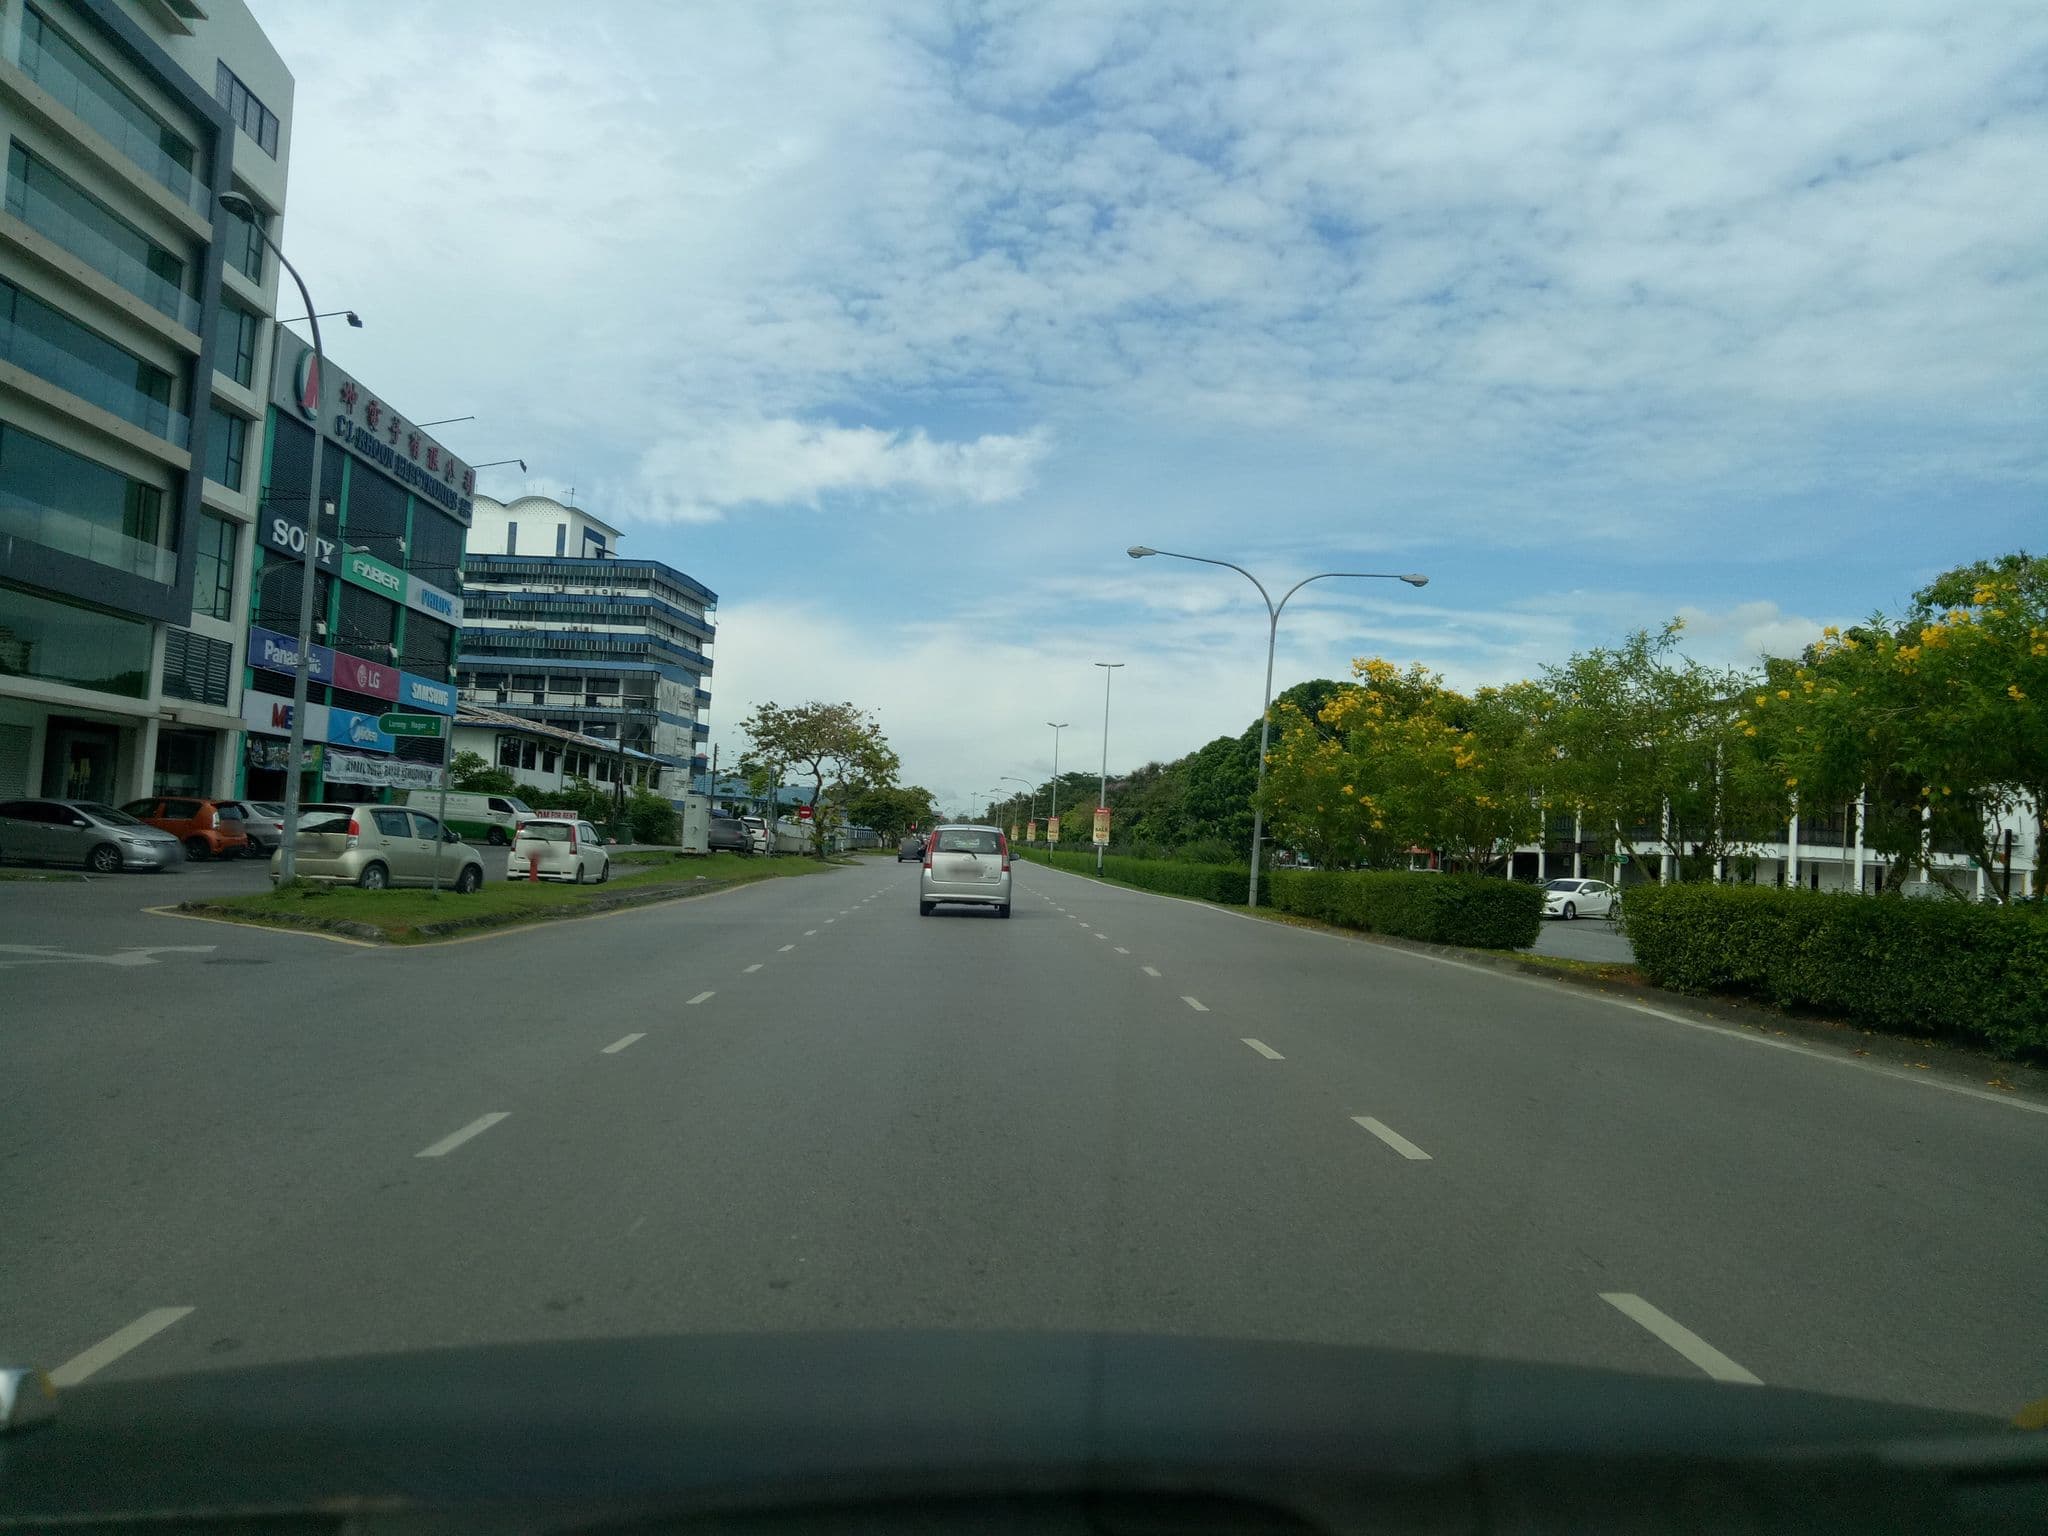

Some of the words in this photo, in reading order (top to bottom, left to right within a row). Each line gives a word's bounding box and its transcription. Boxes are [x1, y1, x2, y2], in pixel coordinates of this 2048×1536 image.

[352, 559, 400, 593] FABER
[421, 588, 453, 616] PHILIPS
[264, 639, 322, 675] Panasic
[411, 682, 450, 707] SAMSUNG
